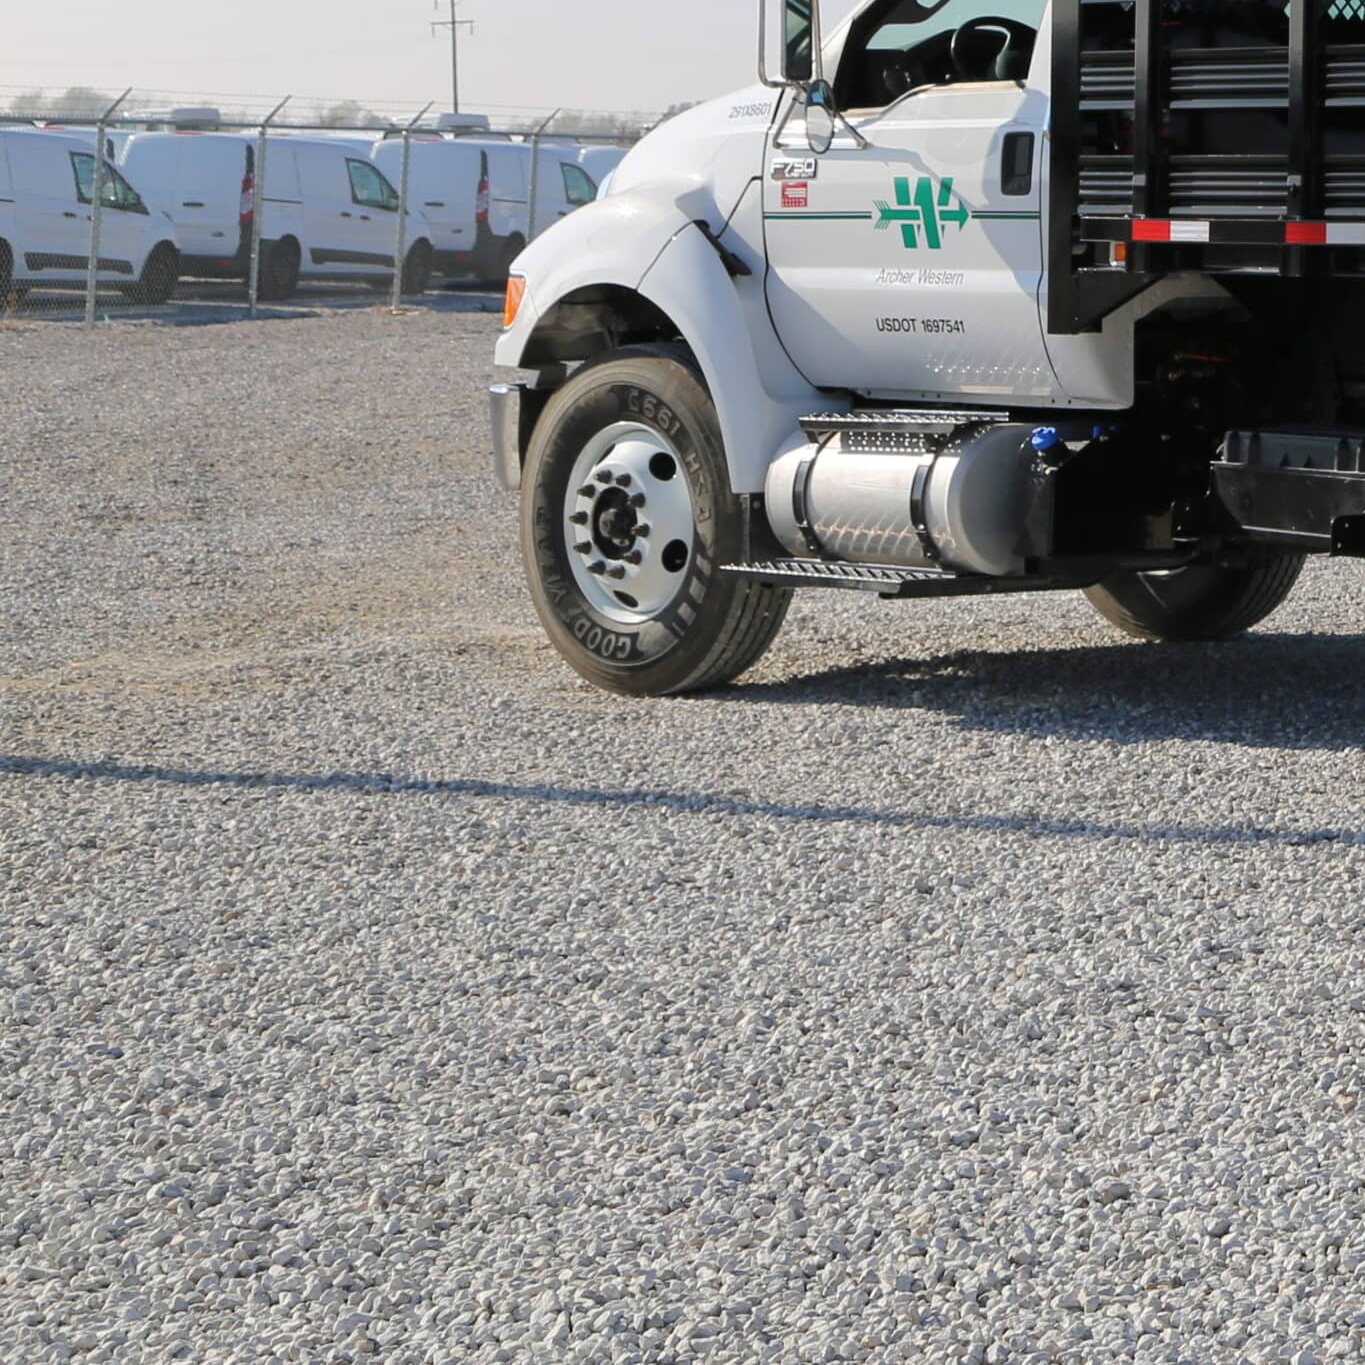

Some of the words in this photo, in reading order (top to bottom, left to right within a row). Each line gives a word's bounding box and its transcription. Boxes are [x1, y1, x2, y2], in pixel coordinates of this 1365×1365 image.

[876, 268, 915, 283] Archer
[918, 268, 964, 285] Western
[876, 318, 916, 332] USDOT
[921, 319, 965, 333] 1697541
